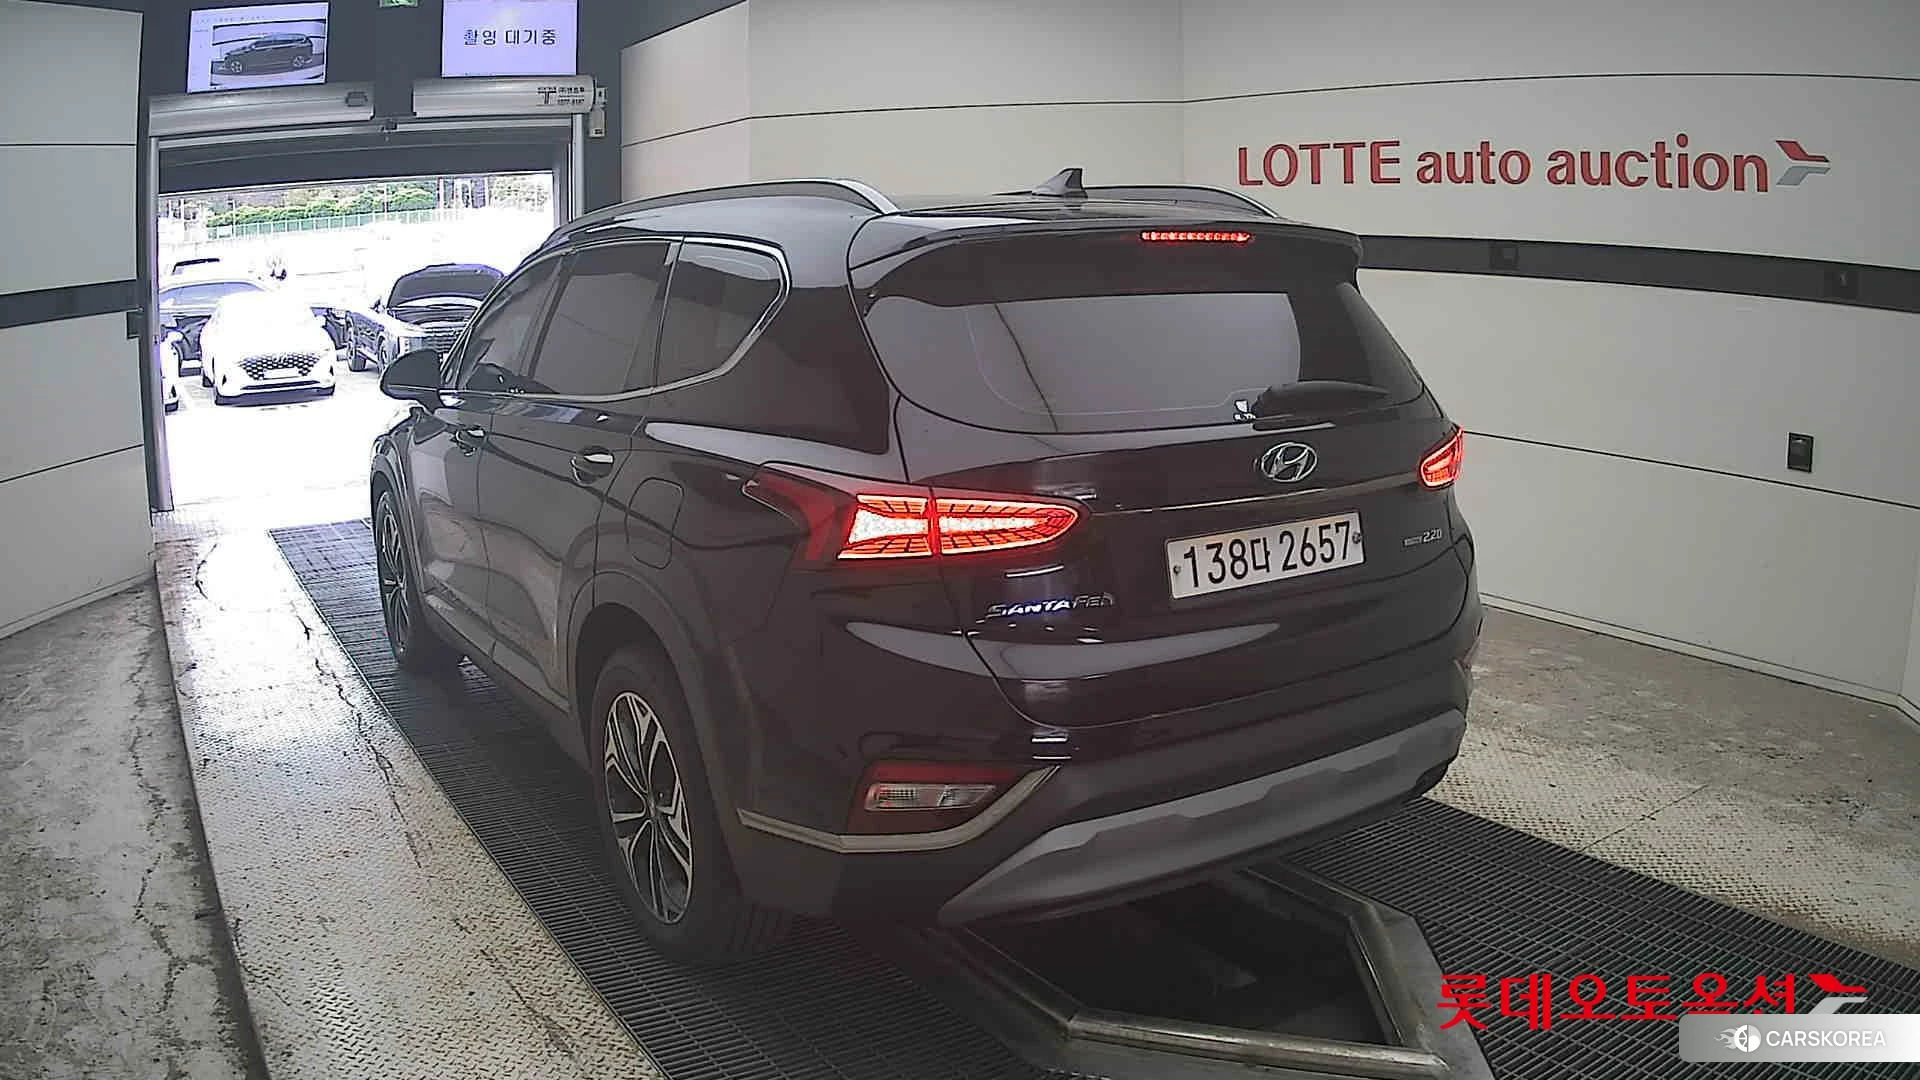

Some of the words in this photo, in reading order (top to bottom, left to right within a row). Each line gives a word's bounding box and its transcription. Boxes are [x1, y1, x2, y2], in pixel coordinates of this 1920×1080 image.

[464, 29, 497, 45] 촬영
[505, 29, 556, 45] 대기중
[1238, 140, 1401, 187] LOTTE
[1417, 140, 1532, 186] auto
[1547, 134, 1769, 193] auction
[1184, 537, 1271, 588] 138다
[1279, 521, 1350, 572] 2657
